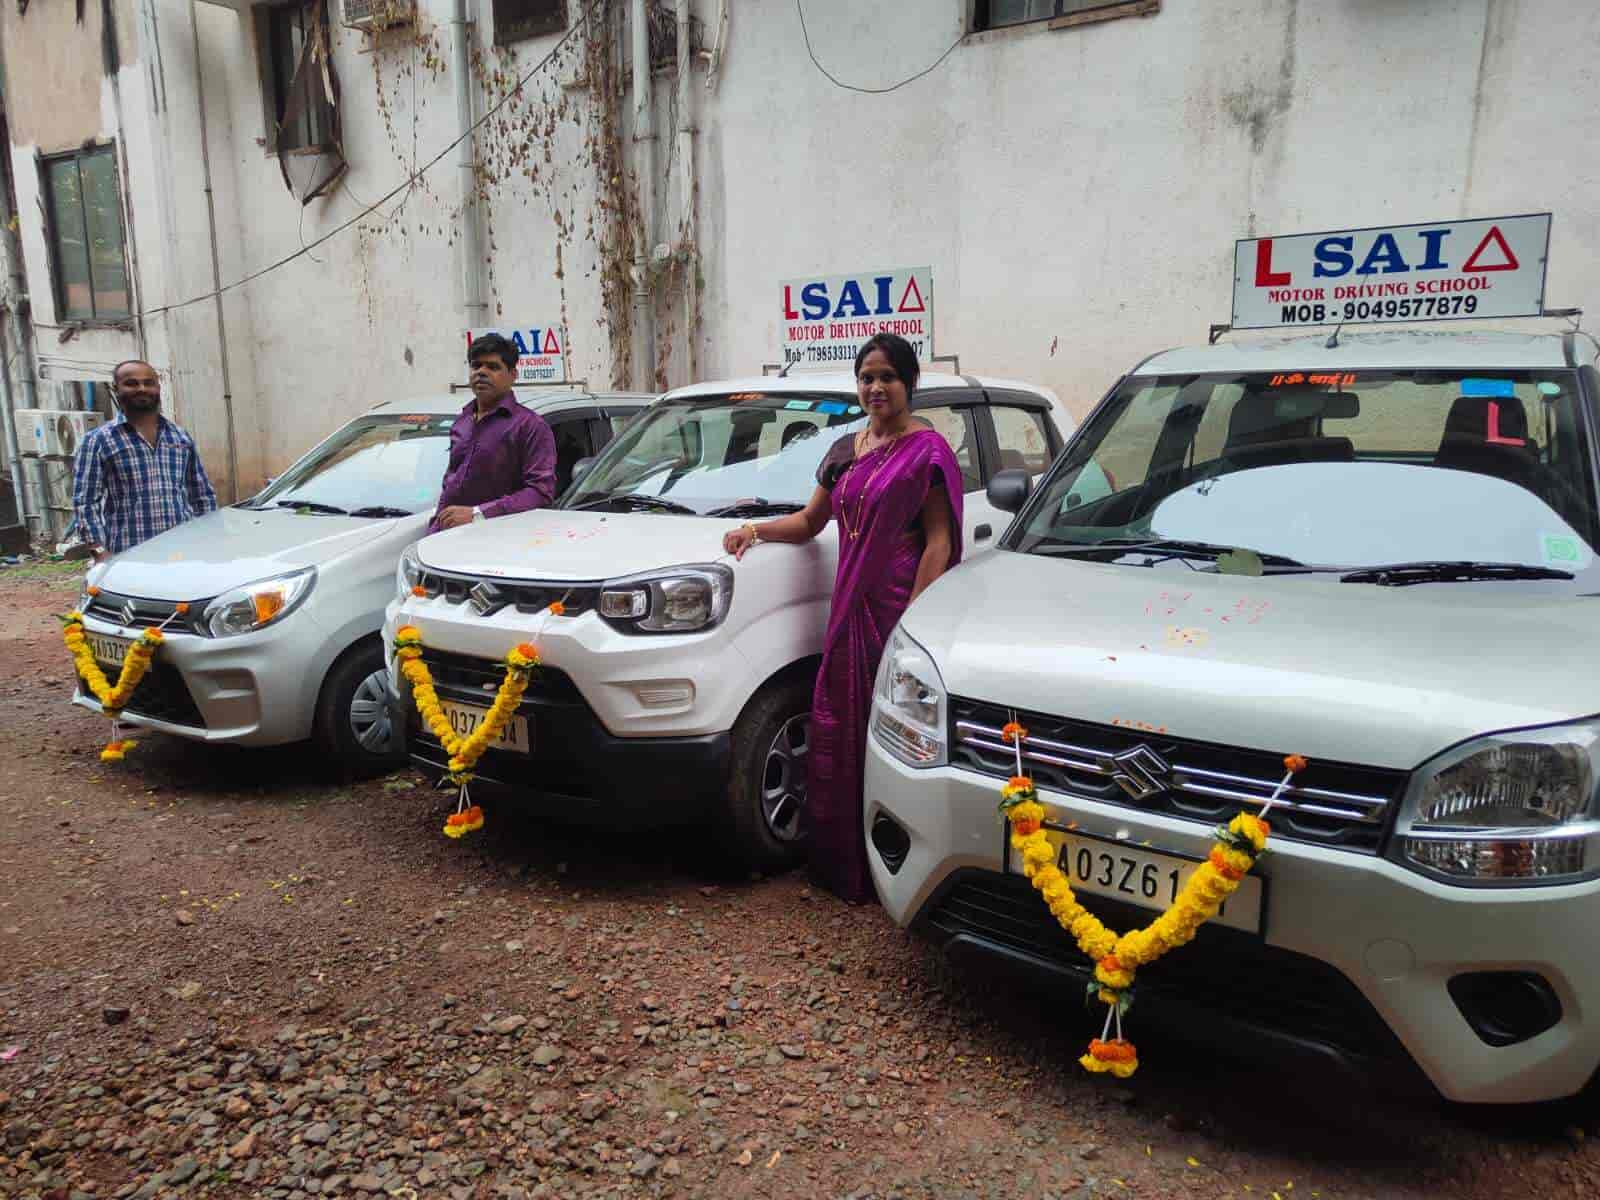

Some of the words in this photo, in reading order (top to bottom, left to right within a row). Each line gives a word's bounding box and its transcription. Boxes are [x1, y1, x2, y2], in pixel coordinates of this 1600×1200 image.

[1255, 239, 1291, 287] L
[1313, 229, 1451, 278] SAI
[784, 285, 799, 320] L
[801, 276, 893, 320] SAI
[1268, 287, 1325, 304] MOTOR
[1333, 282, 1409, 300] DRIVING
[1414, 276, 1491, 294] SCHOOL
[1281, 304, 1325, 323] MOB
[1343, 294, 1478, 320] 9049577879
[788, 326, 825, 341] MOTOR
[830, 321, 876, 338] DRIVING
[879, 319, 924, 336] SCHOOL
[1485, 401, 1525, 446] L
